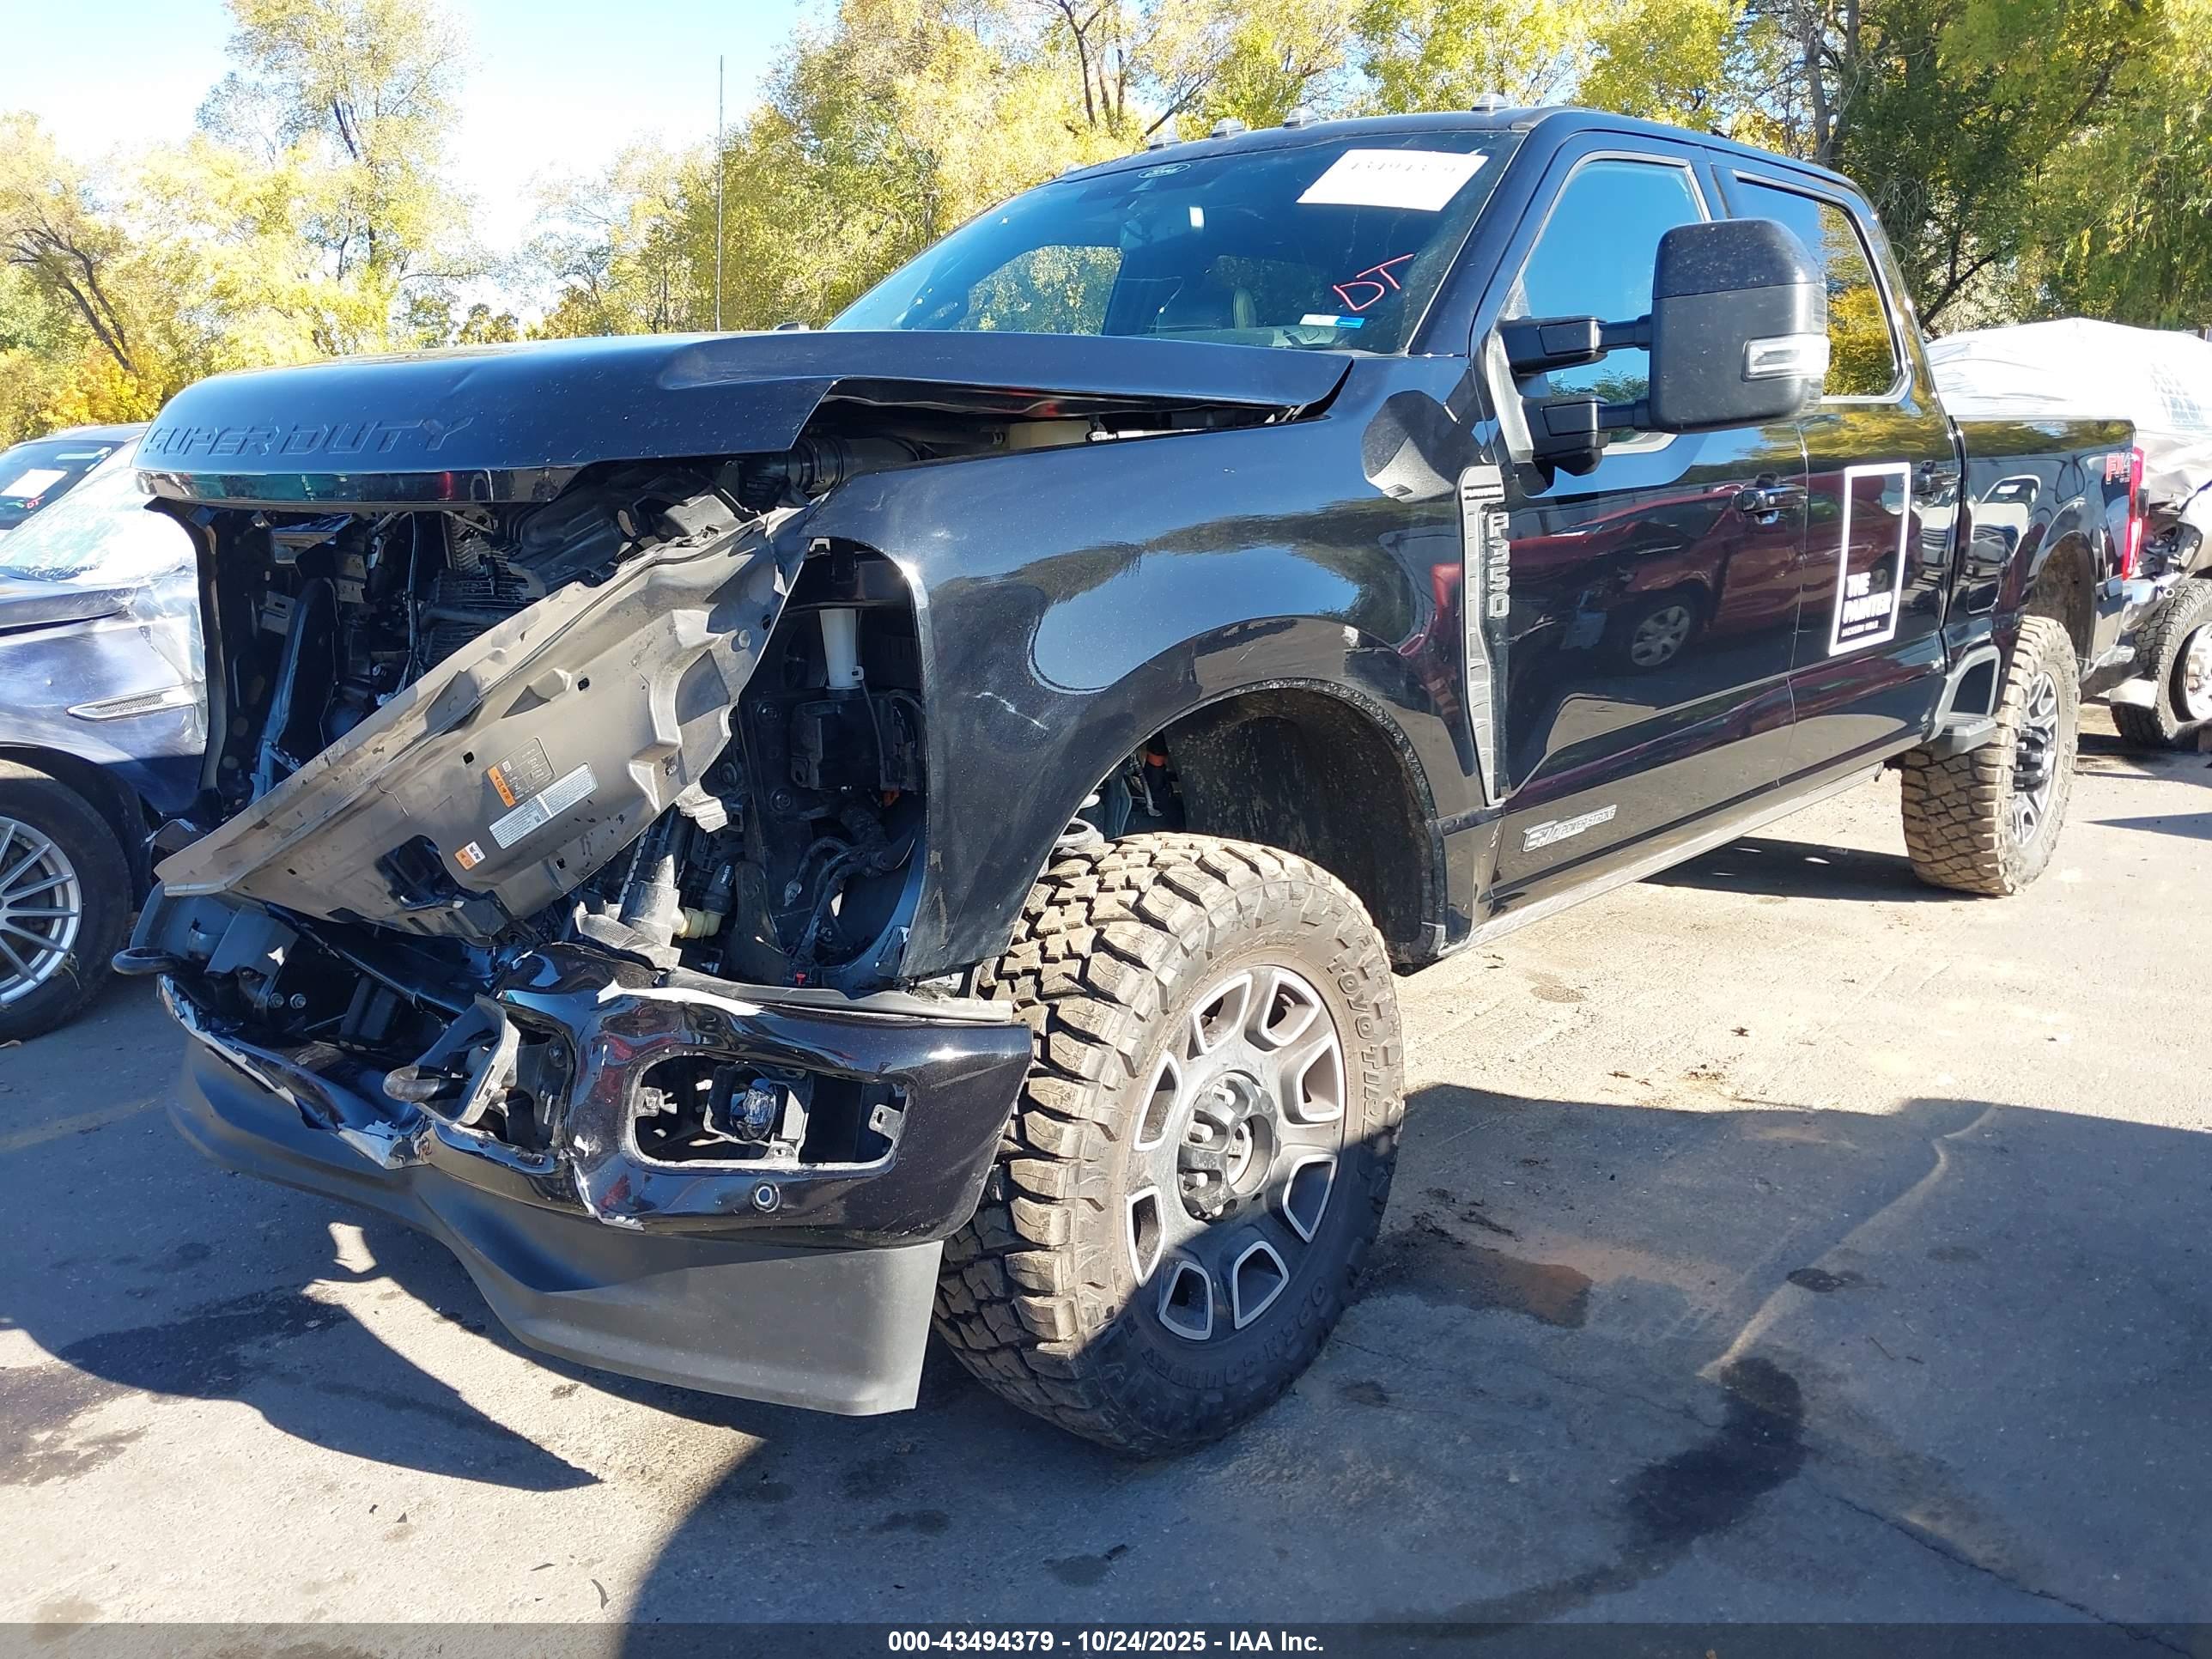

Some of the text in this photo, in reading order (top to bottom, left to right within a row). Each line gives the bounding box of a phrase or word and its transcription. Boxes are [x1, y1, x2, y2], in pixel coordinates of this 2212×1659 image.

[1333, 253, 1416, 311] DT
[144, 416, 473, 456] SUPER DUTY
[1487, 512, 1510, 618] F350
[1847, 572, 1871, 598] THE
[1842, 591, 1893, 624] PAINTER
[1326, 953, 1374, 1041] TOYO
